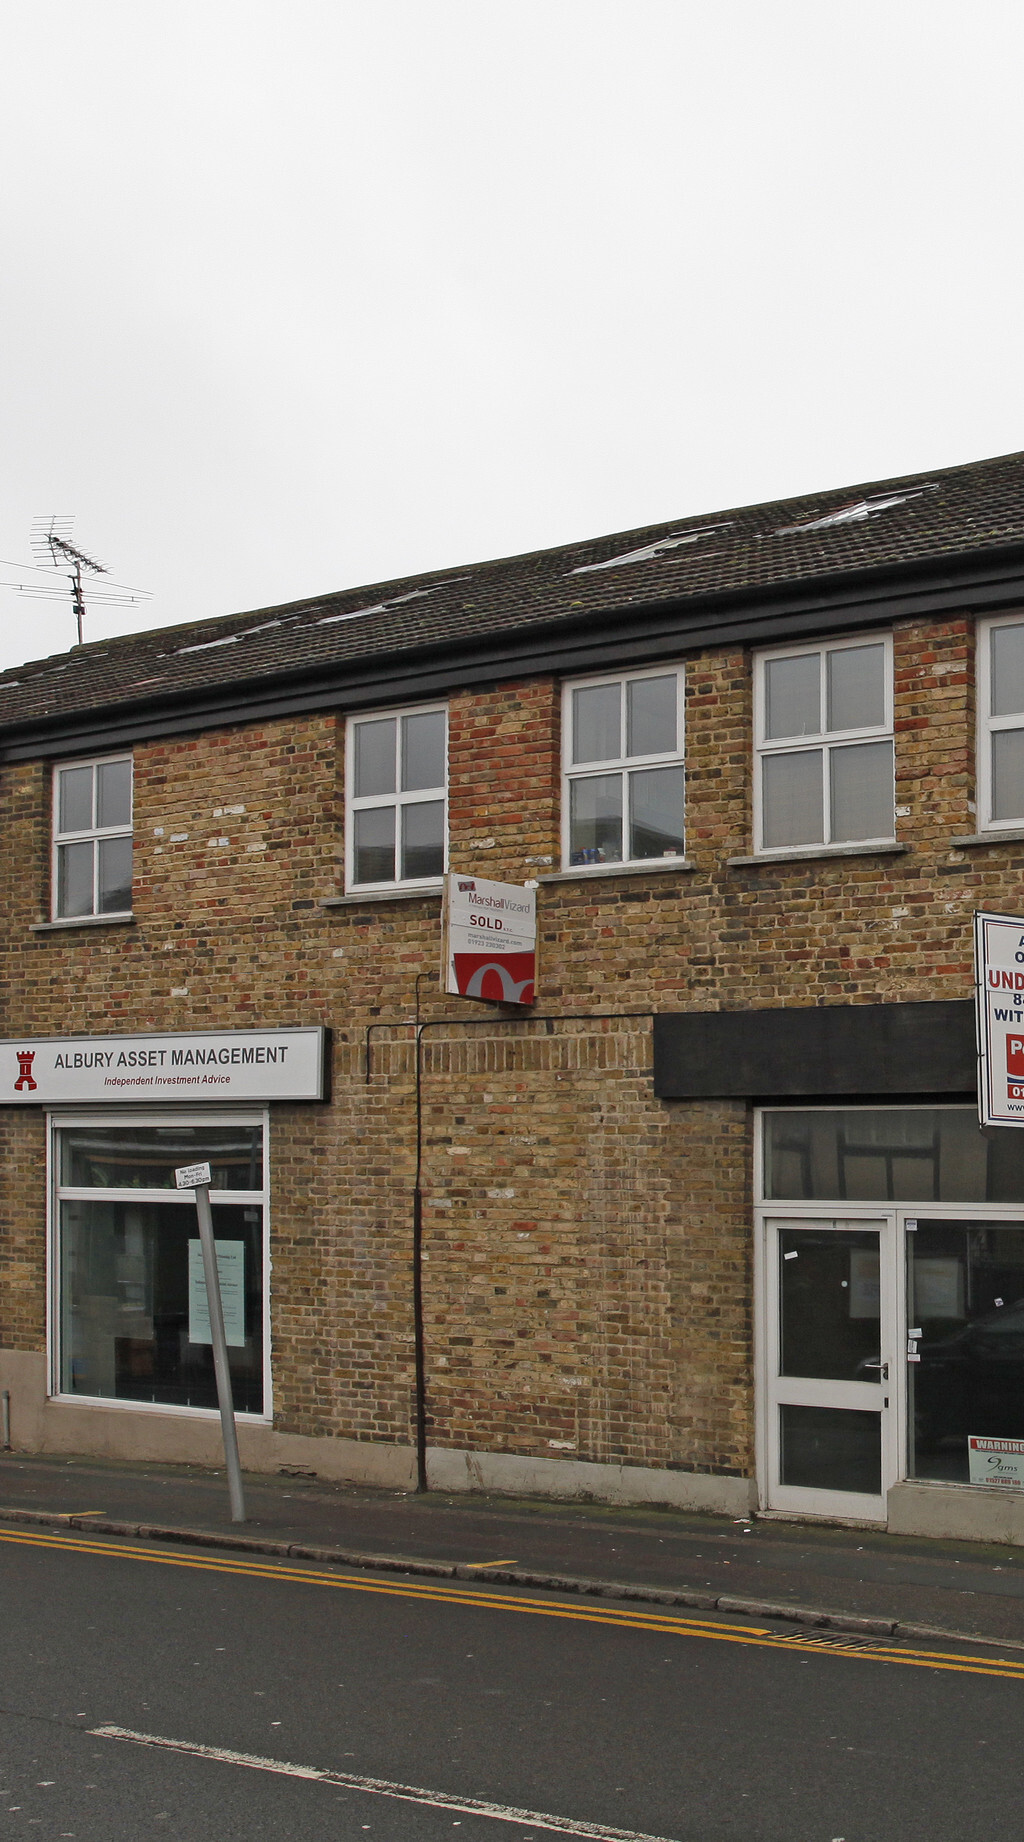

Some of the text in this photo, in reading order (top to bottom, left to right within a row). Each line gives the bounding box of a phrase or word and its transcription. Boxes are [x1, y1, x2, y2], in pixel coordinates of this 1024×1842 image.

[468, 892, 530, 913] MarshallVizard
[470, 914, 502, 930] SOLD
[54, 1046, 288, 1069] ALBURY ASSET MANAGEMENT
[104, 1074, 230, 1087] Independent Investment Advice
